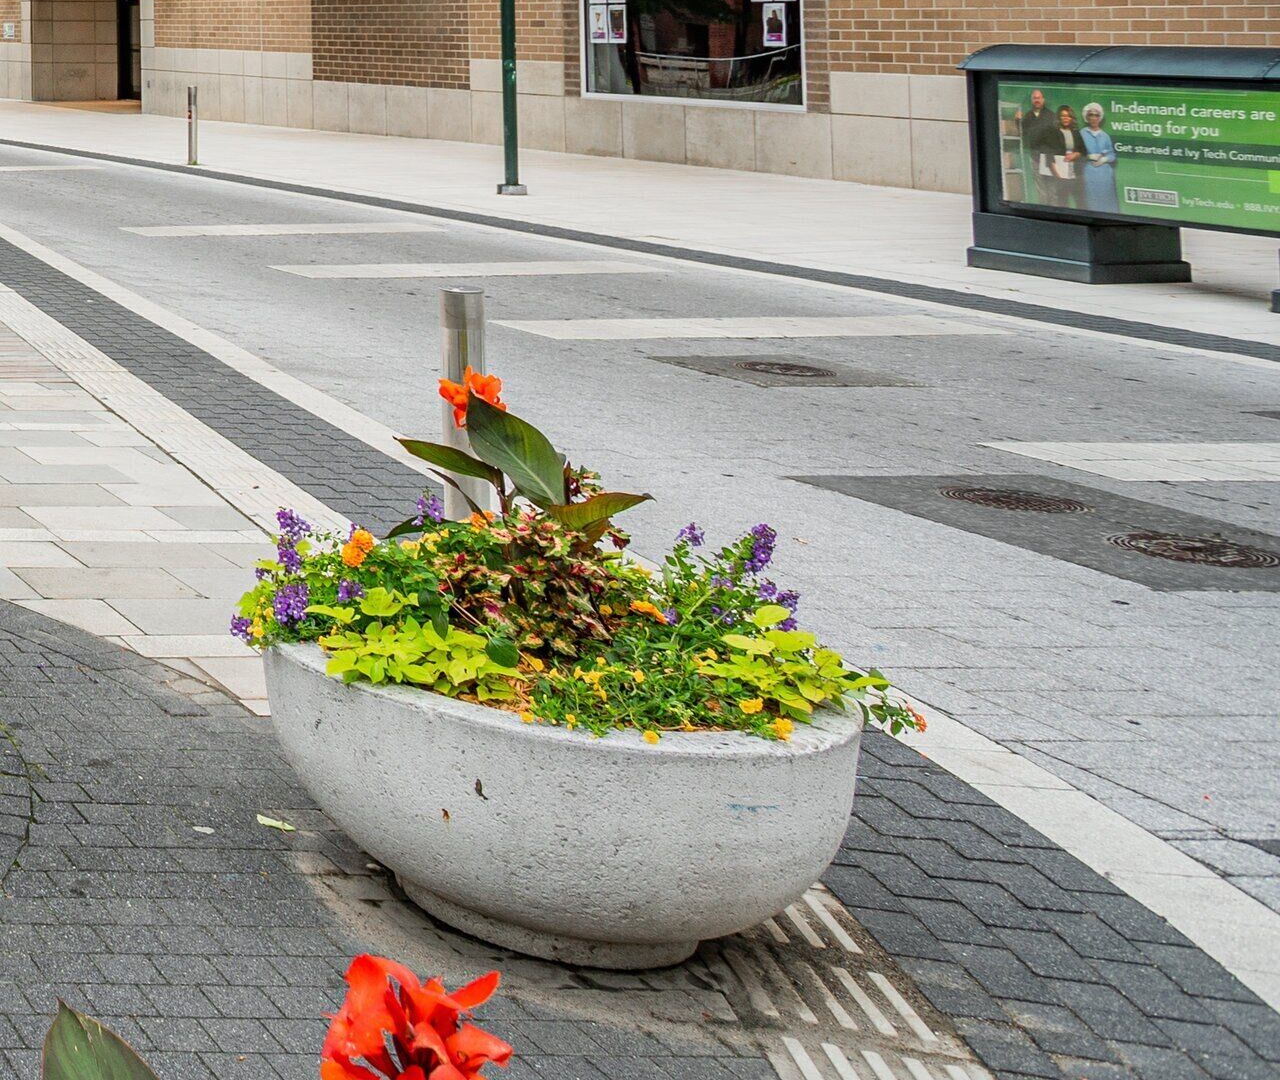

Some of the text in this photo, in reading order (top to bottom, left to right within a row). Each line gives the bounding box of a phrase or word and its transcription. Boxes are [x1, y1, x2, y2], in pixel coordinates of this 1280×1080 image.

[1111, 100, 1276, 121] In-demand careers are
[1111, 120, 1219, 139] waiting for you
[1114, 142, 1132, 152] Get
[1134, 145, 1170, 156] started
[1172, 149, 1183, 157] at
[1185, 148, 1200, 159] Ivy
[1201, 148, 1226, 159] Tech
[1182, 197, 1235, 210] IvyTech.edu
